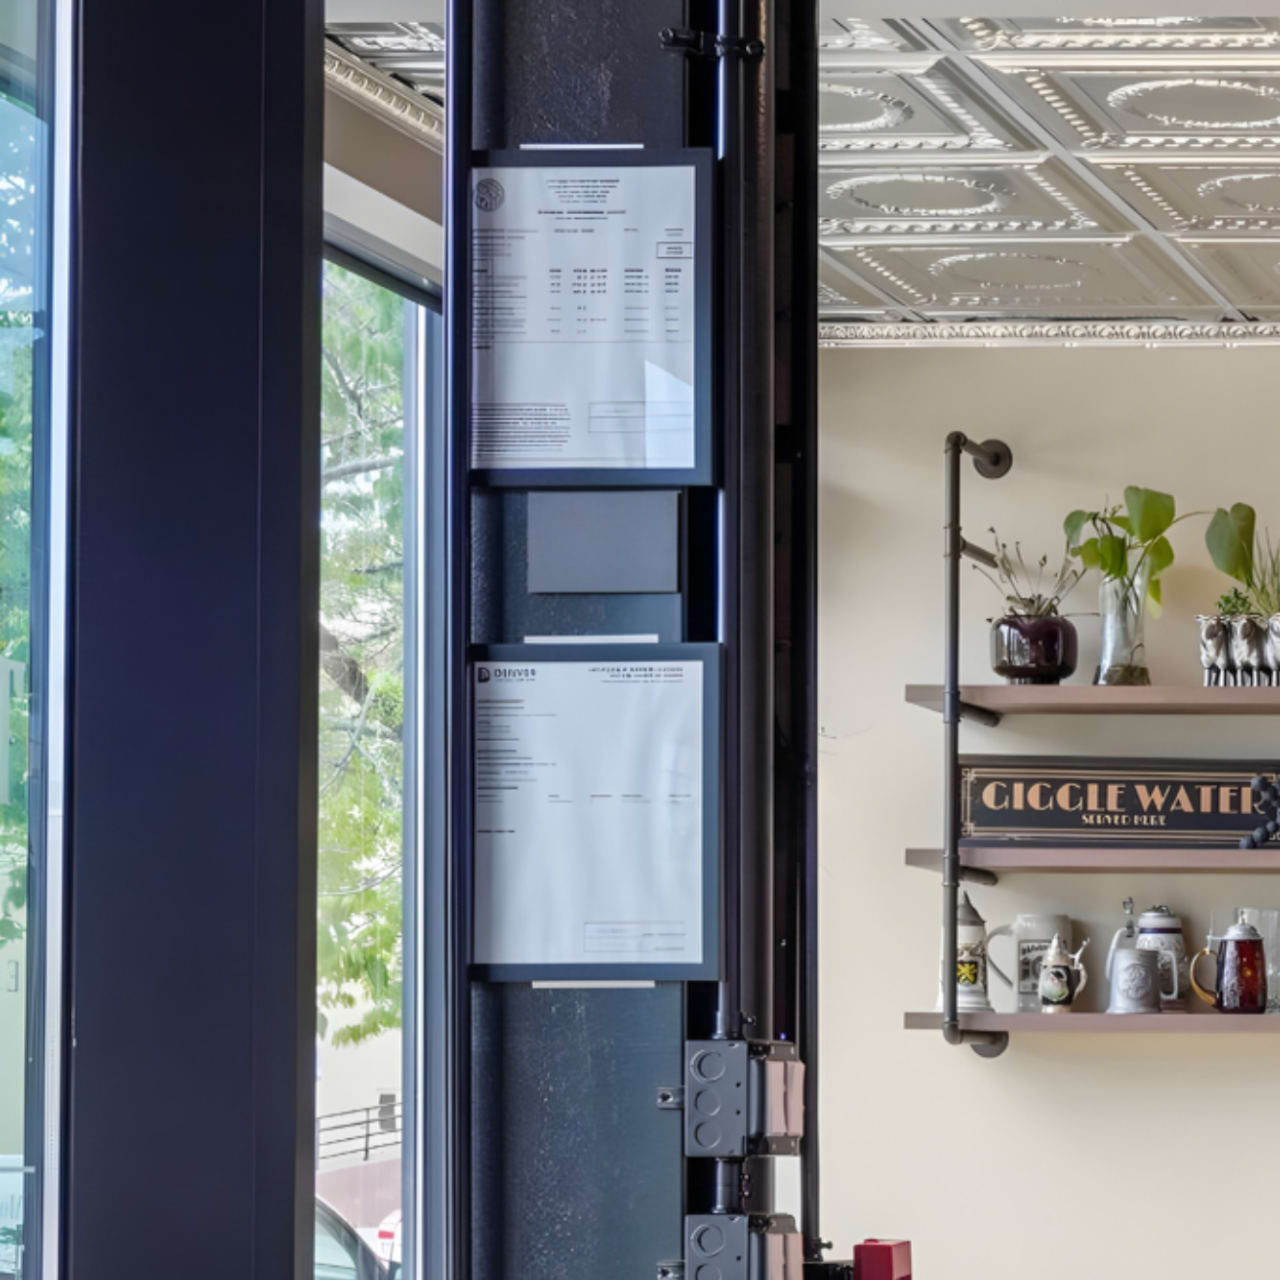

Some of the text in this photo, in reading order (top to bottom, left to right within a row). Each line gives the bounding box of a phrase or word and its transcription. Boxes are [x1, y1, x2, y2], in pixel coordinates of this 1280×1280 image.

[981, 781, 1266, 815] GIGGLE WATER
[1081, 813, 1131, 826] SERVED
